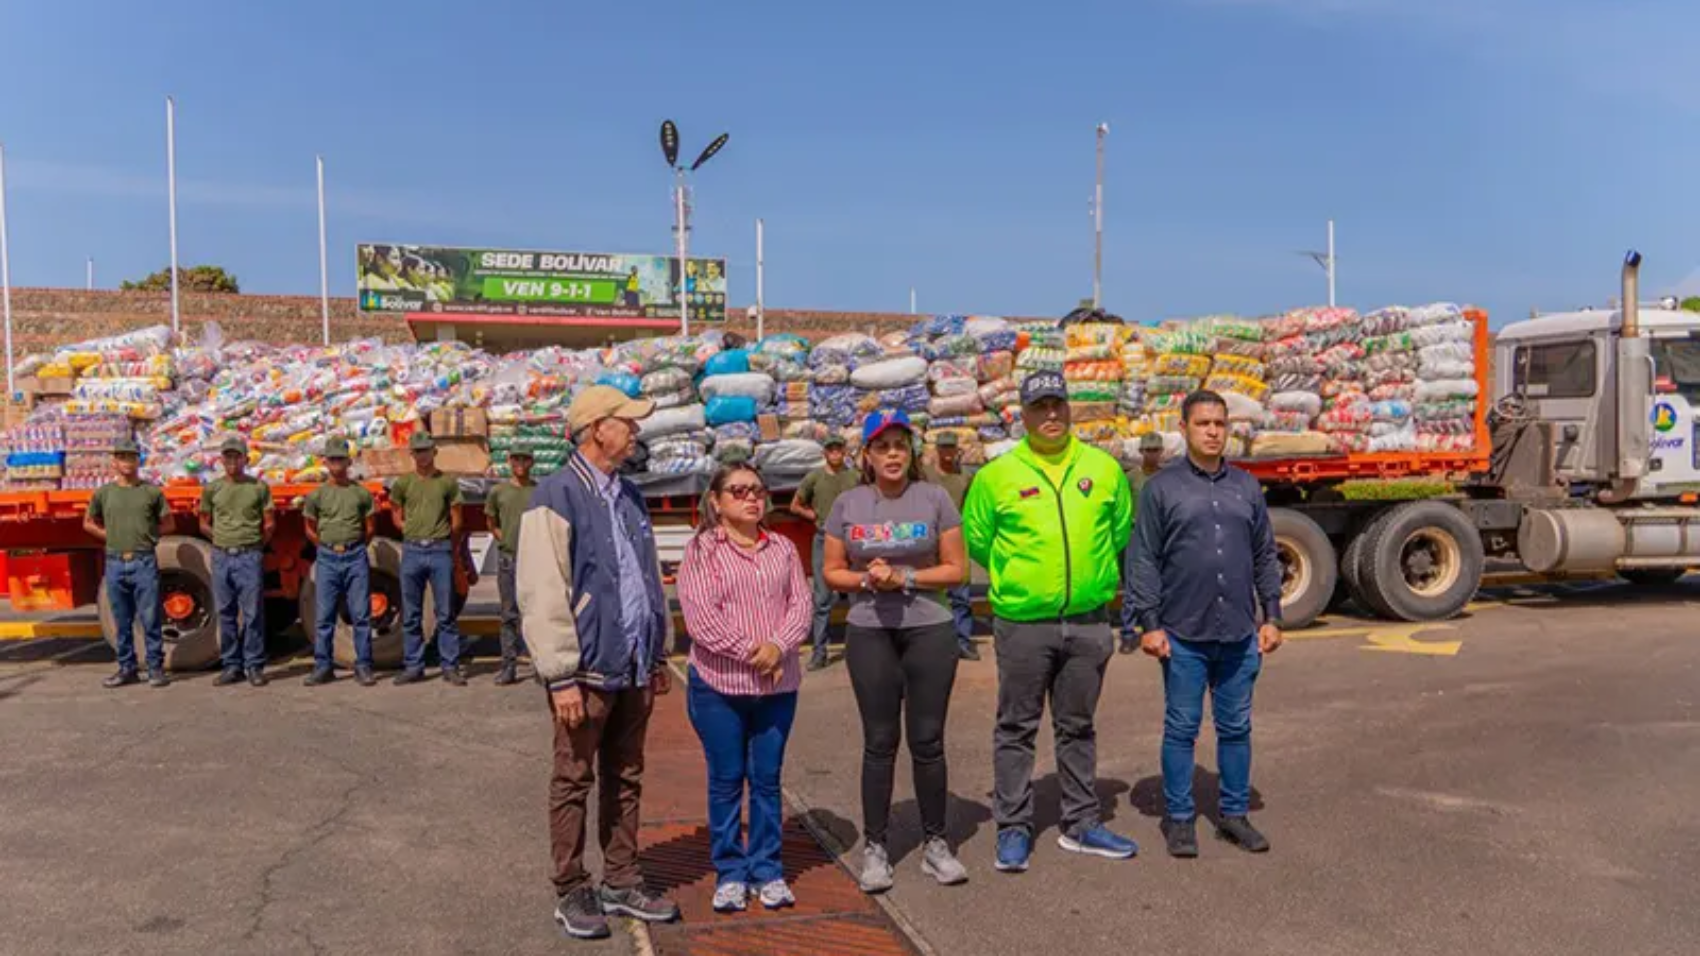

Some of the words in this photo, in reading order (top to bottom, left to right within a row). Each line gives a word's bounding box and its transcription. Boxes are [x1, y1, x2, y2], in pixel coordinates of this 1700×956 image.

[482, 252, 534, 269] SEDE
[540, 253, 622, 271] BOLÍVAR
[503, 280, 544, 296] VEN
[550, 282, 591, 299] 9-1-1
